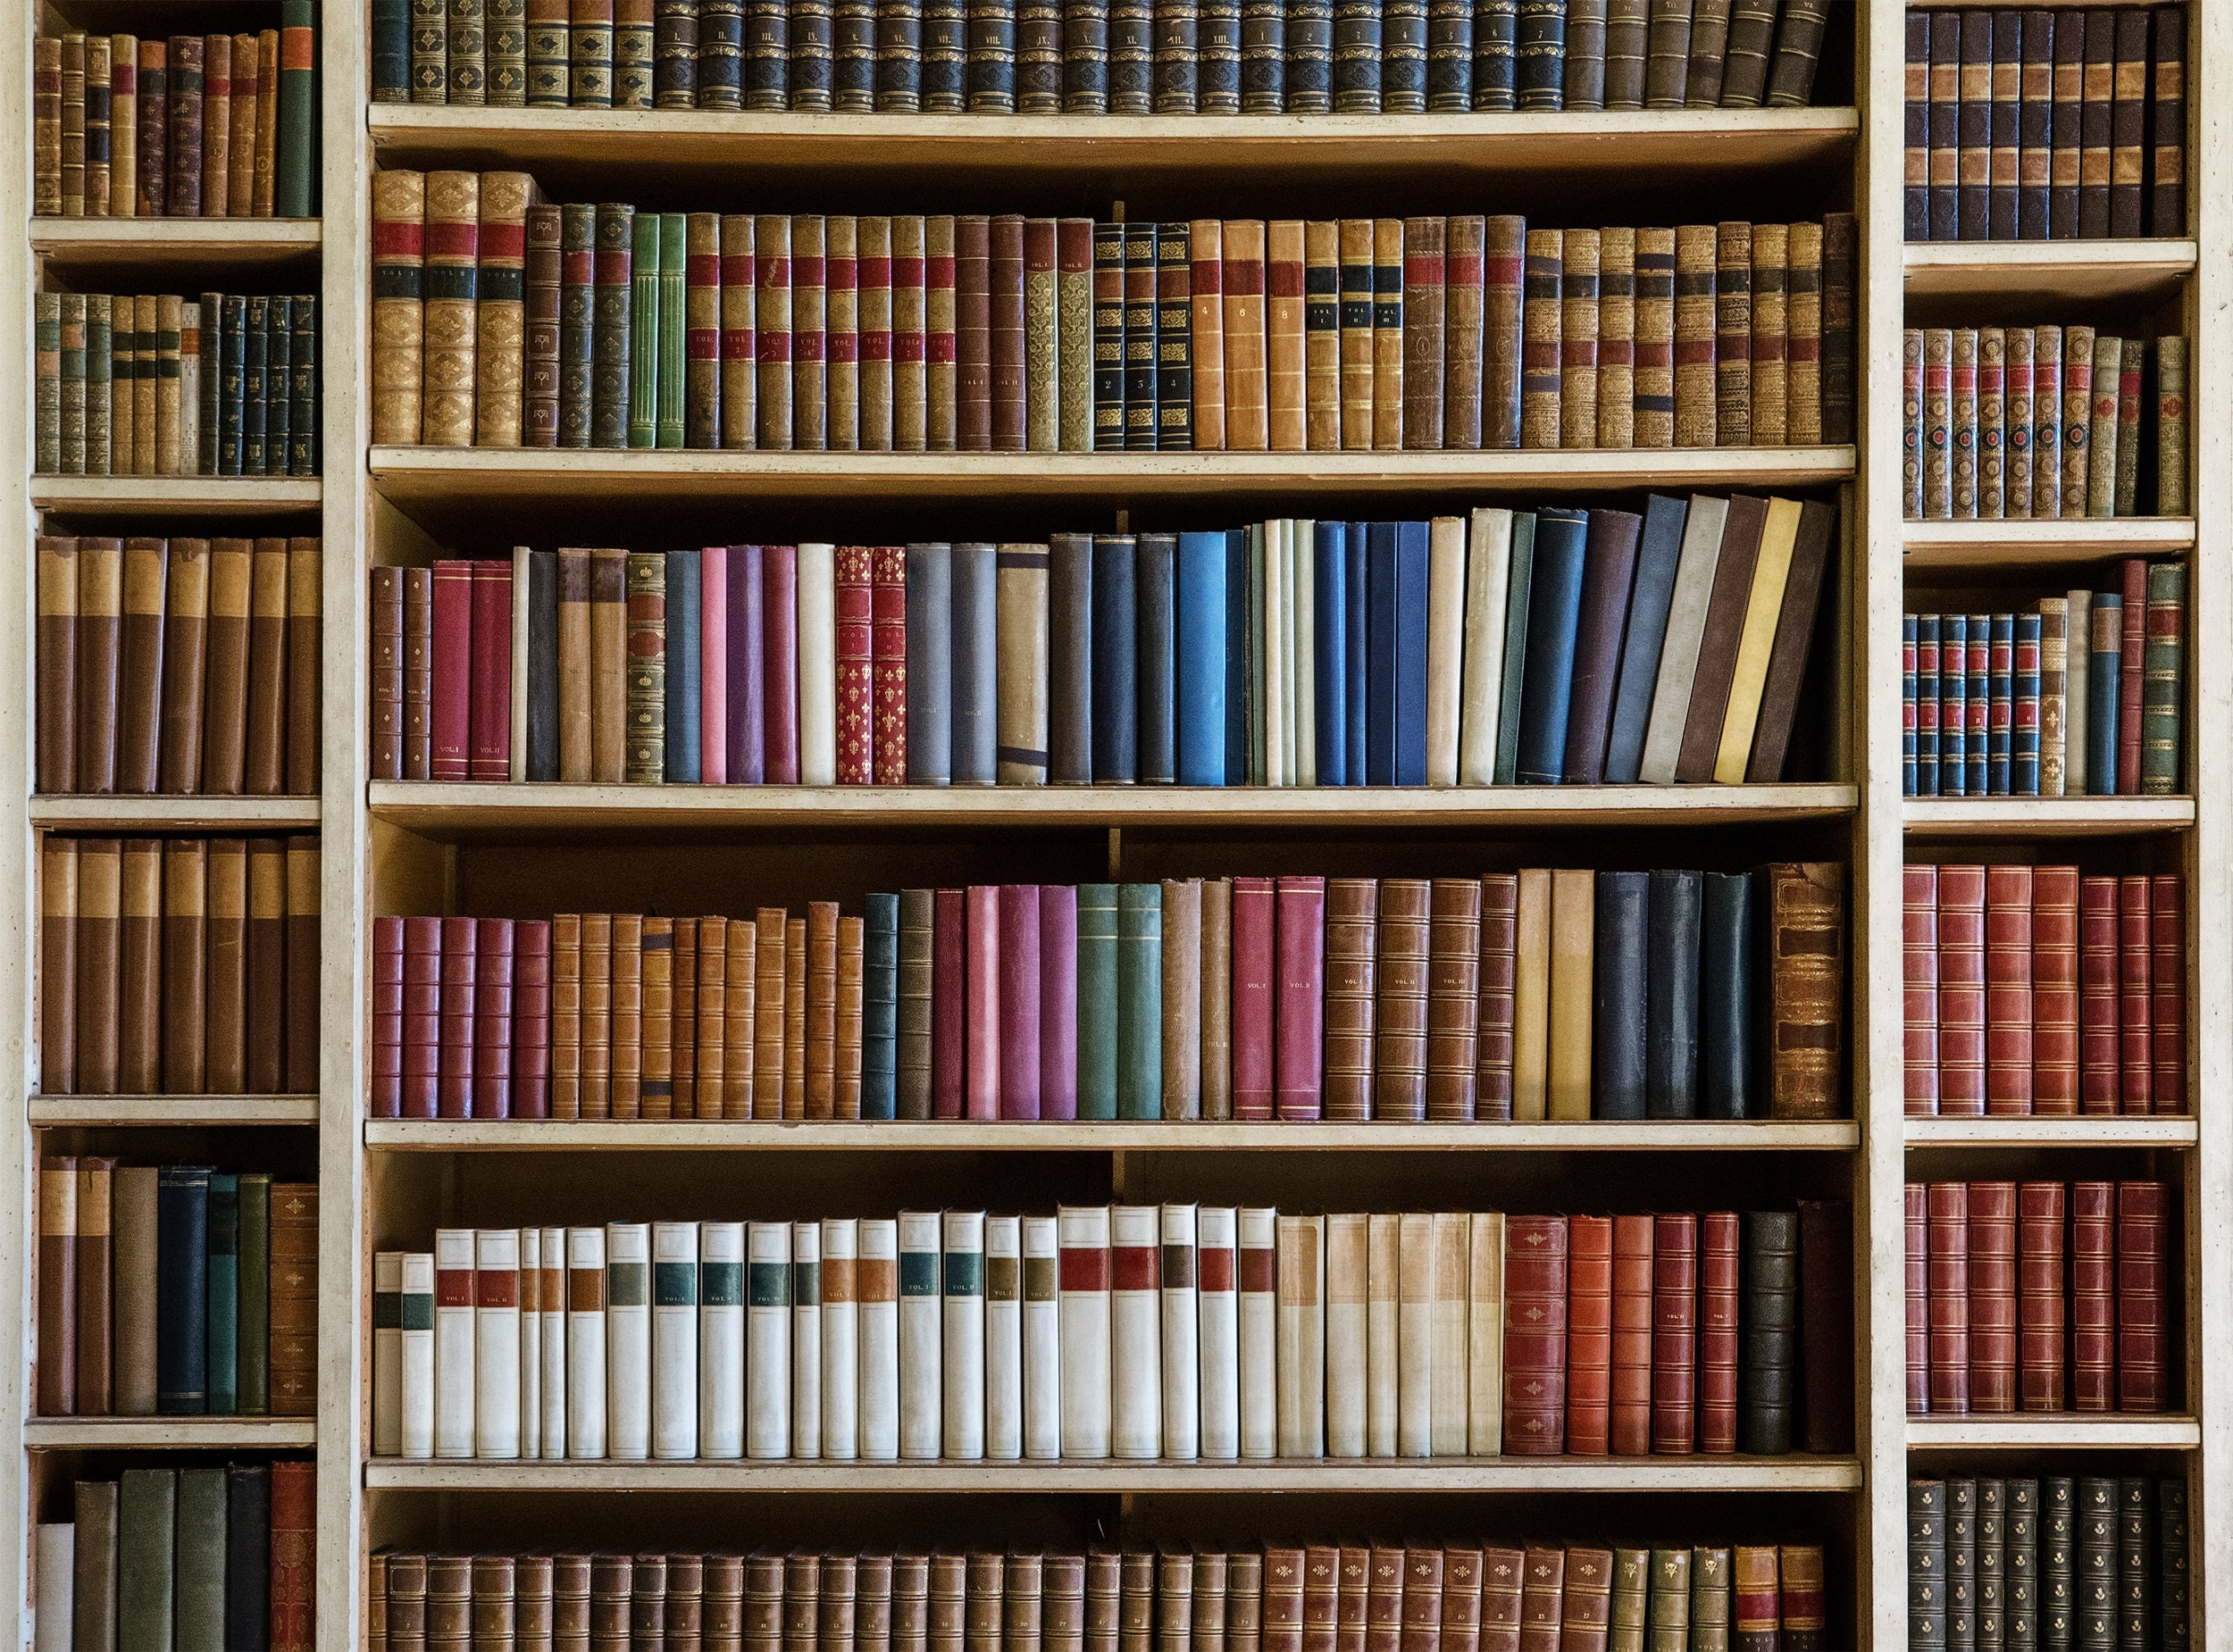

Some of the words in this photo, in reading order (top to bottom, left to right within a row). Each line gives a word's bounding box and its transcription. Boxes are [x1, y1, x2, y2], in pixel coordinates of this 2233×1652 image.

[718, 31, 727, 39] II.
[762, 32, 774, 41] III.
[1201, 306, 1208, 315] 4
[1239, 308, 1246, 317] 6
[1282, 310, 1288, 320] 8
[1105, 380, 1111, 389] 2
[1137, 380, 1143, 388] 3
[1170, 380, 1176, 388] 4
